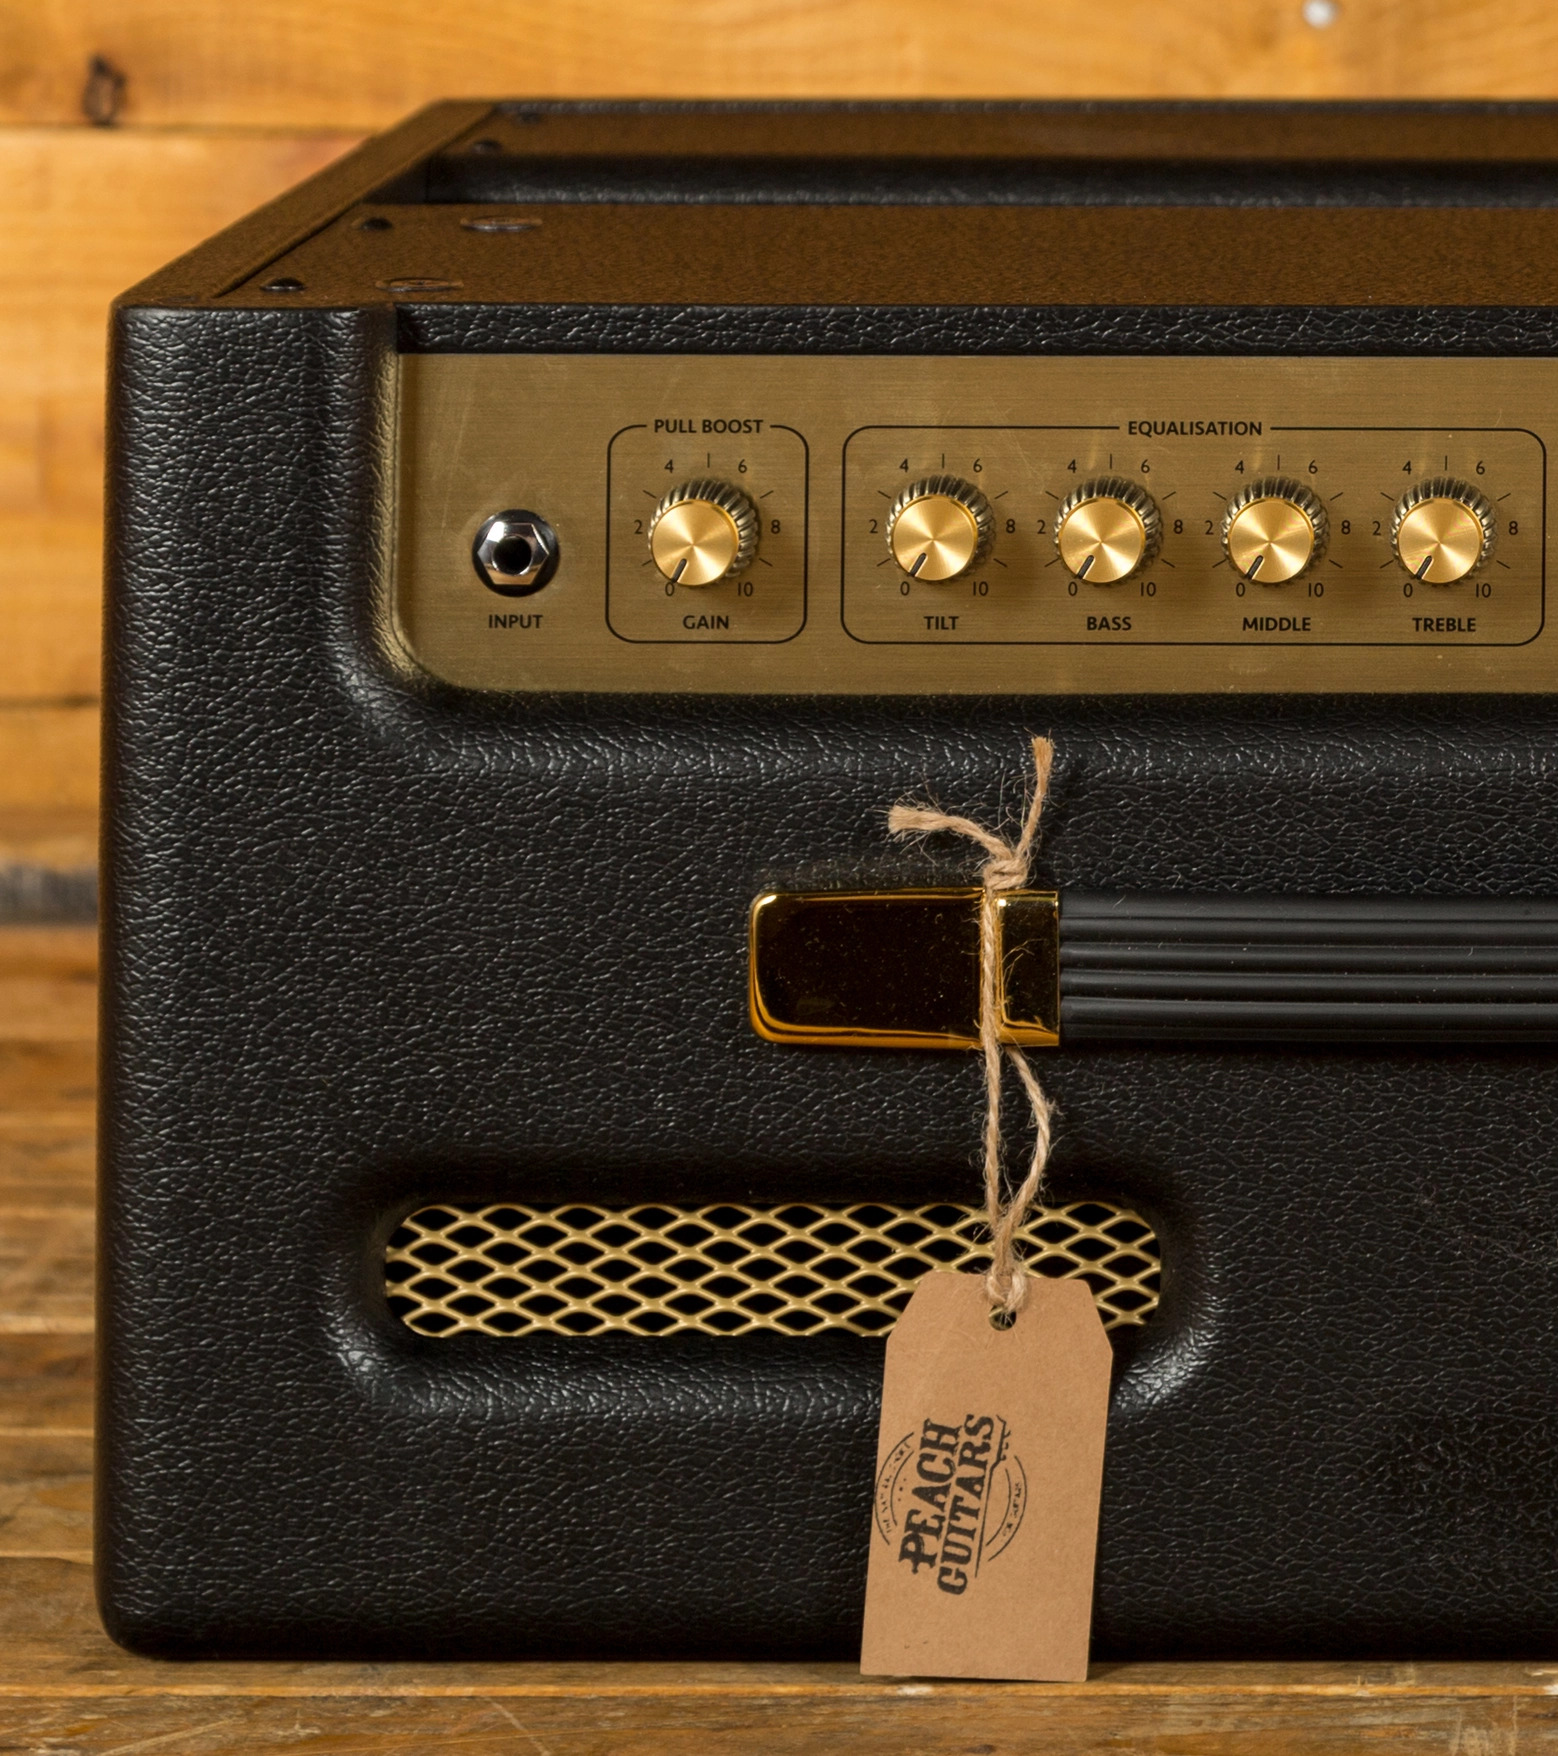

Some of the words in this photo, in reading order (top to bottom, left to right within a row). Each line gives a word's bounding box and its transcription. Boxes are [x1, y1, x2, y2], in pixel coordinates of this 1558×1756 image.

[654, 419, 697, 434] PULL
[702, 418, 764, 434] BOOST
[1128, 420, 1262, 438] EQUALISATION
[664, 459, 674, 474] 4
[737, 458, 748, 474] 6
[899, 458, 909, 473] 4
[972, 458, 983, 473] 6
[1067, 459, 1077, 474] 4
[1140, 459, 1151, 474] 6
[1234, 460, 1245, 475] 4
[1308, 459, 1319, 475] 6
[1402, 460, 1412, 475] 4
[1475, 460, 1486, 476] 6
[634, 519, 643, 535] 2
[770, 519, 781, 535] 8
[869, 518, 879, 534] 2
[1005, 518, 1016, 534] 8
[1037, 519, 1047, 535] 2
[1173, 519, 1184, 535] 8
[1205, 519, 1214, 536] 2
[1340, 519, 1351, 536] 8
[1372, 520, 1382, 536] 2
[1508, 520, 1519, 536] 8
[664, 581, 675, 597] 0
[737, 581, 754, 598] 10
[899, 580, 911, 597] 0
[972, 581, 989, 597] 10
[1067, 581, 1078, 597] 0
[1140, 581, 1157, 597] 10
[1235, 582, 1246, 598] 0
[1308, 582, 1325, 598] 10
[1403, 582, 1414, 598] 0
[1475, 582, 1492, 599] 10
[488, 614, 544, 629] INPUT
[682, 615, 730, 630] GAIN
[923, 615, 959, 631] TILT
[1086, 616, 1132, 631] BASS
[1242, 616, 1311, 632] MIDDLE
[1412, 617, 1476, 633] TREBLE
[898, 1418, 963, 1575] PEACH
[936, 1413, 995, 1596] GUITARS
